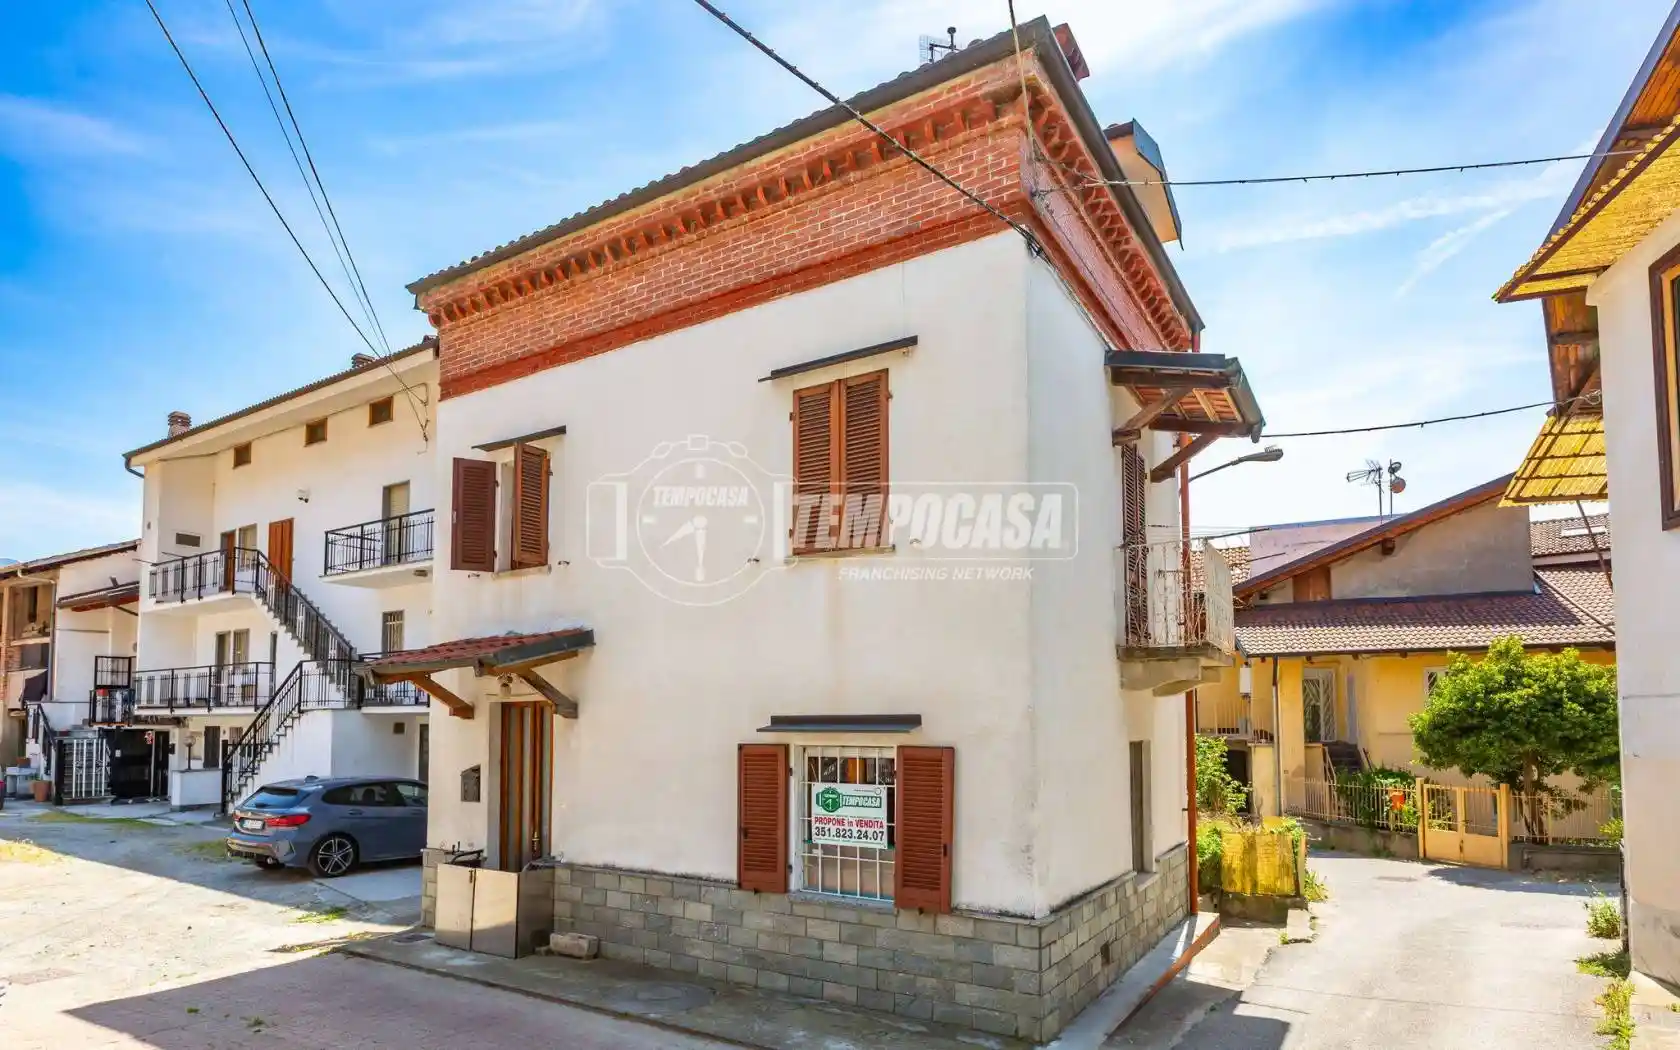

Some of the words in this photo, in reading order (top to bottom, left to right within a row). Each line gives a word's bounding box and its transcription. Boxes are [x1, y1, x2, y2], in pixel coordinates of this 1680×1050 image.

[843, 795, 880, 807] TEMPOCASA
[814, 817, 845, 827] PROPONE
[814, 826, 885, 841] 351.823.24.07
